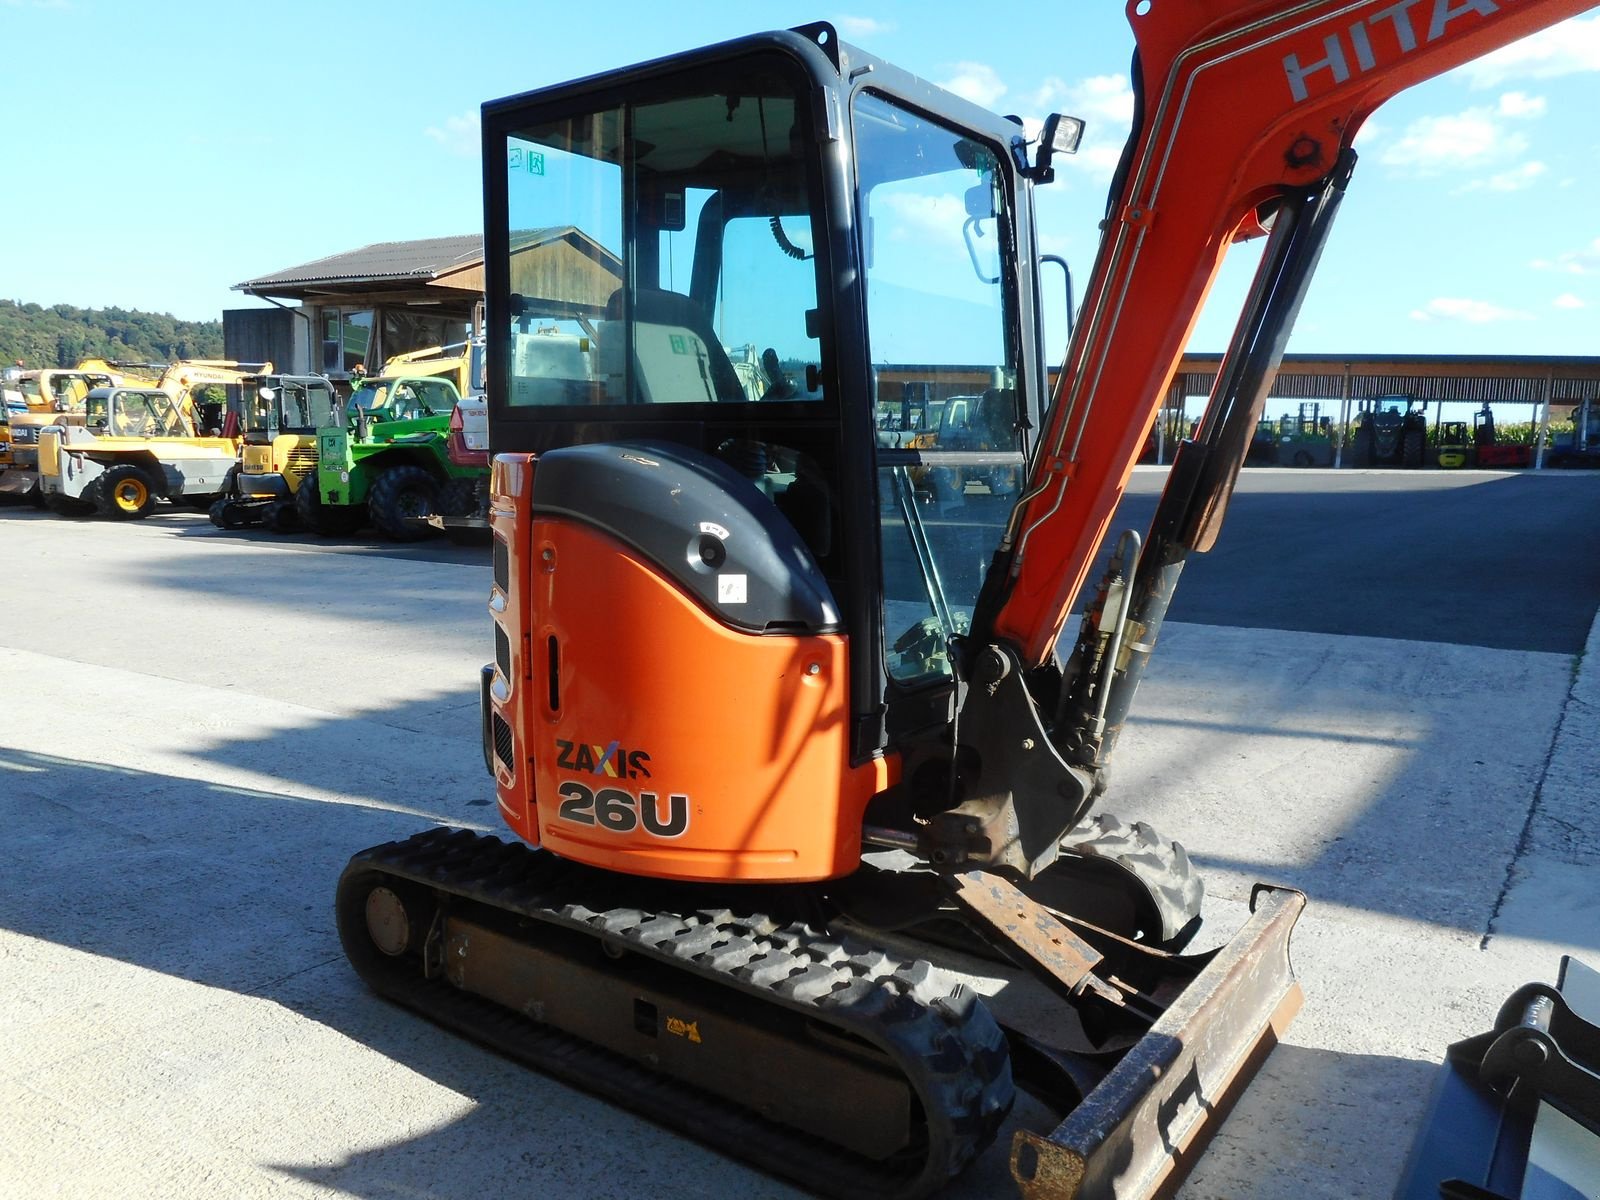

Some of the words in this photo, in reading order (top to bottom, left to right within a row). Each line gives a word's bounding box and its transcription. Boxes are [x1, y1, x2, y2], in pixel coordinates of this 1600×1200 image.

[1282, 0, 1500, 103] HITA
[194, 372, 224, 380] HYUNDAI
[556, 738, 652, 779] ZAXIS
[558, 781, 690, 839] 26U
